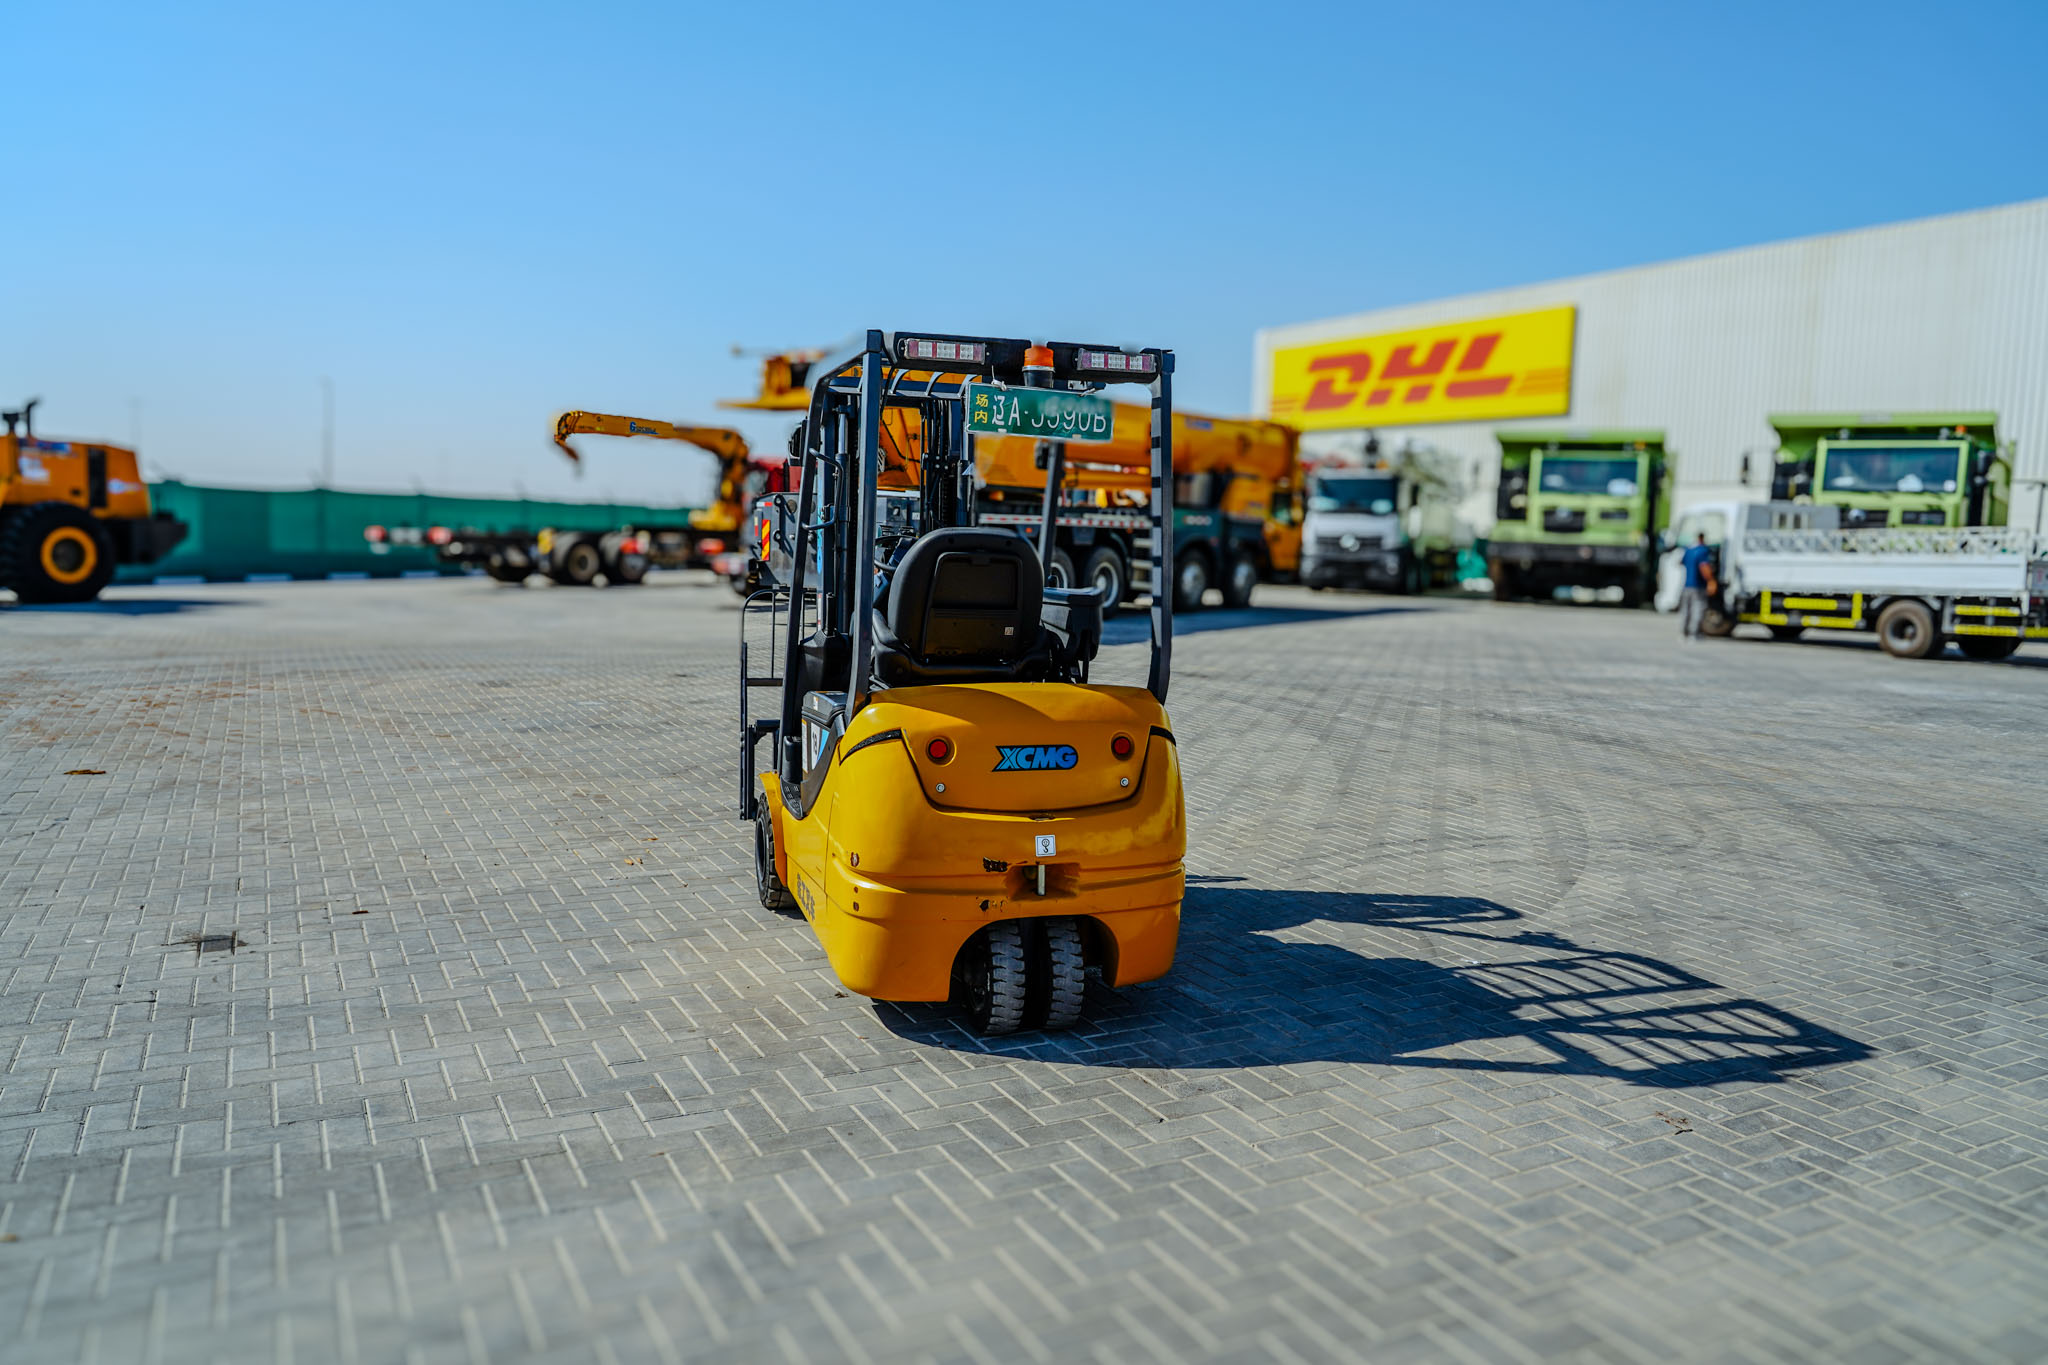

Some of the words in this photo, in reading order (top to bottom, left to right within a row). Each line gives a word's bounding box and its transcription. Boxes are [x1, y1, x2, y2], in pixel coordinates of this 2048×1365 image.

[1303, 332, 1514, 412] DHL
[974, 393, 989, 424] 场内
[995, 745, 1078, 770] XCMG
